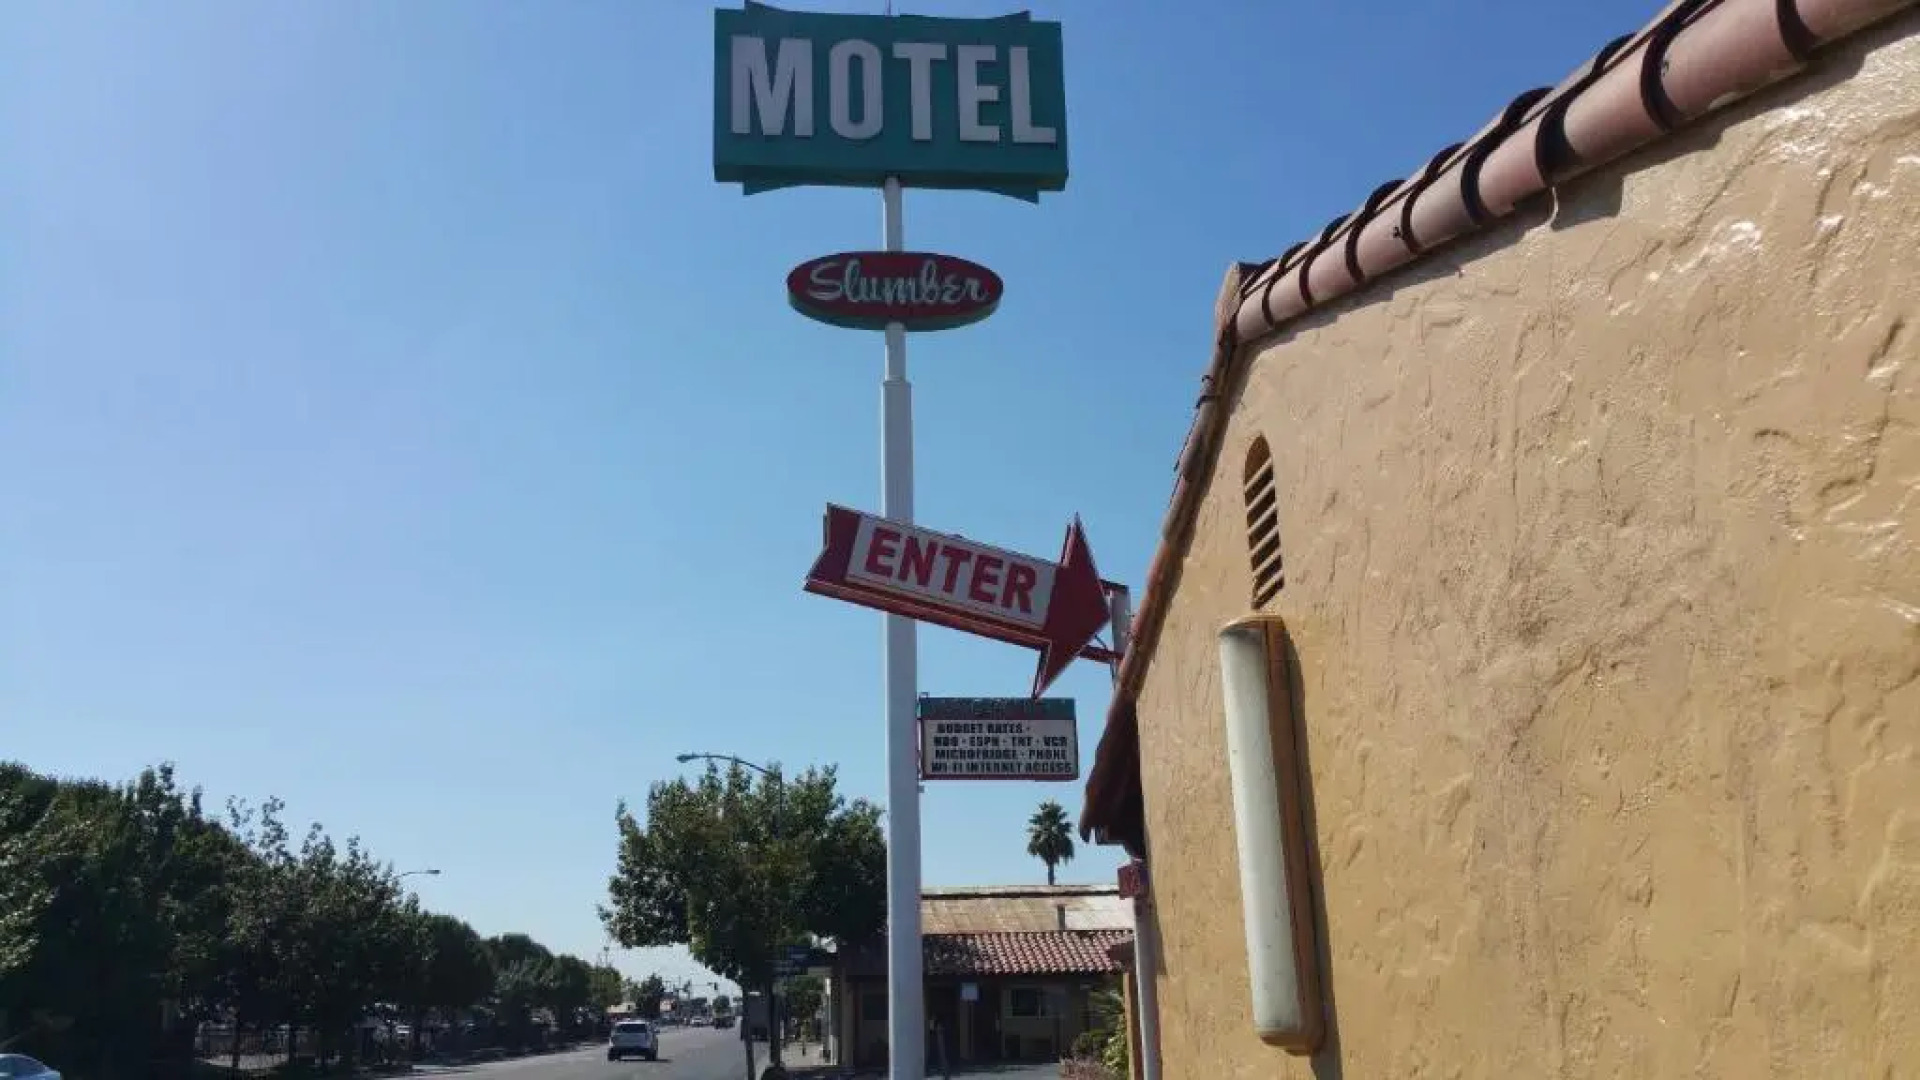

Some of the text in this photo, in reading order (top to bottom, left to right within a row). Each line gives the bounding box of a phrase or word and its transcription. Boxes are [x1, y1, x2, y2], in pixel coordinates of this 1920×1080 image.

[731, 36, 1057, 143] MOTEL
[808, 259, 989, 306] Slumber
[864, 526, 1037, 614] ENTER
[937, 723, 1023, 733] BUDGET RATES
[933, 736, 1067, 747] HBO ESPN TNT VCR
[1028, 749, 1067, 760] PHONE
[965, 762, 1022, 773] INTERNET
[1025, 762, 1072, 773] ACCESS
